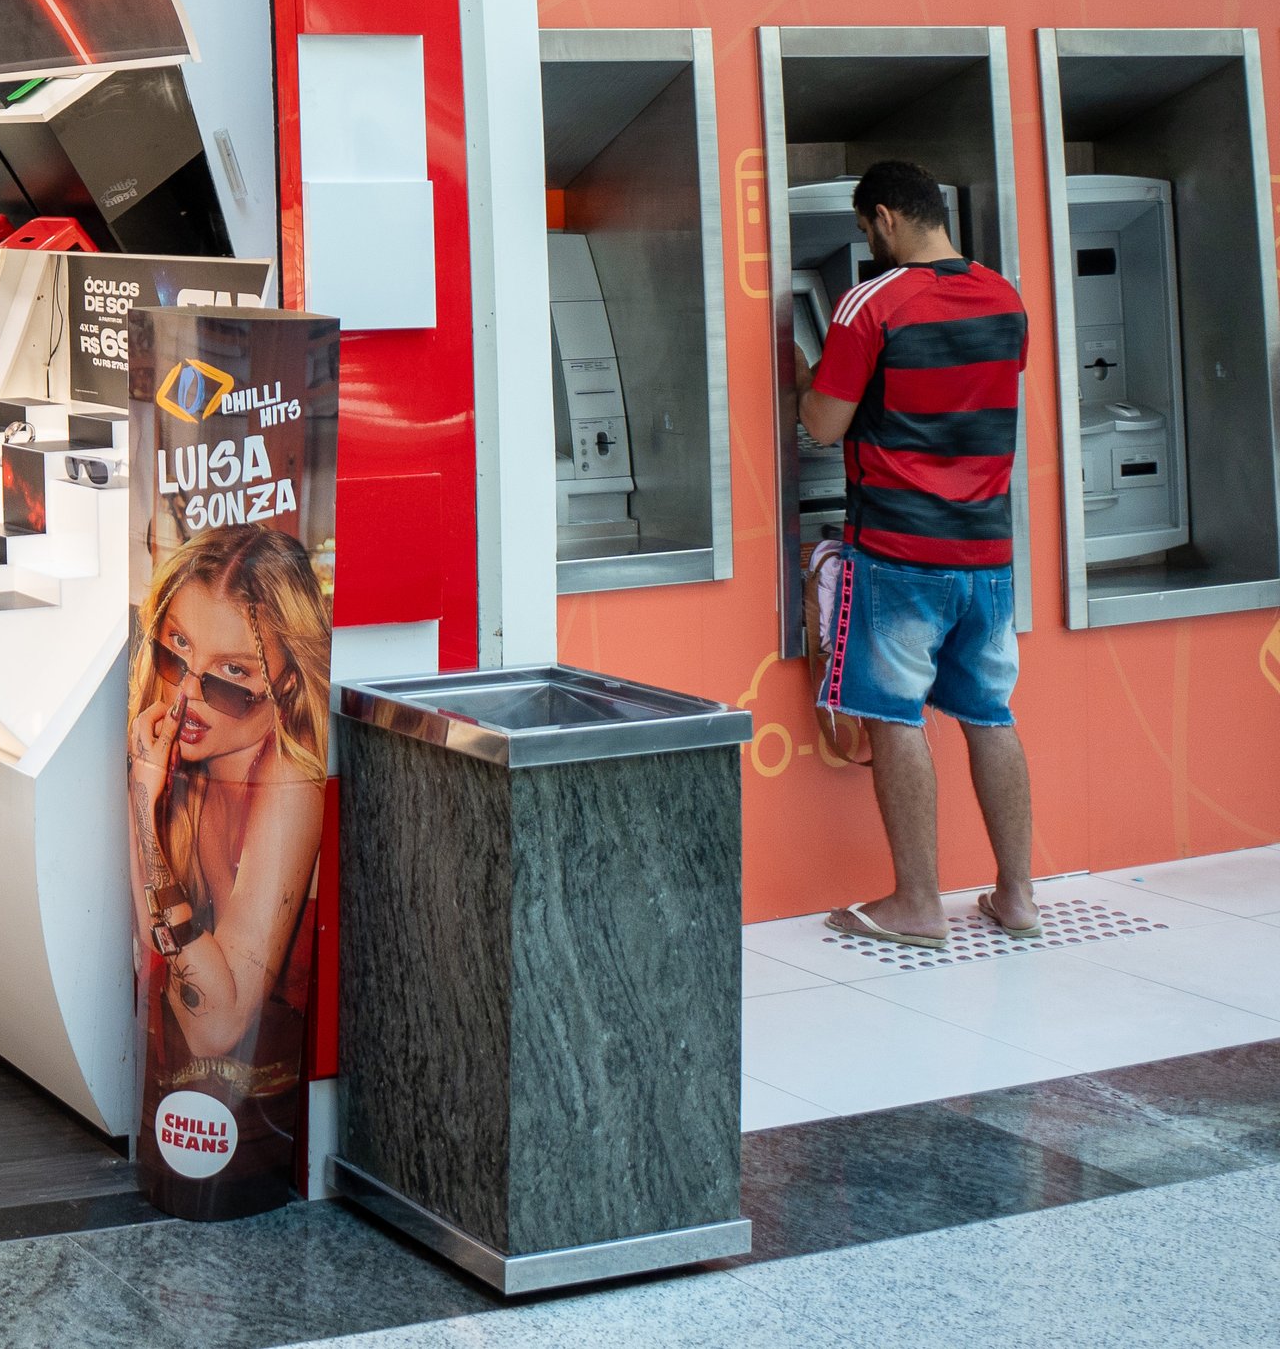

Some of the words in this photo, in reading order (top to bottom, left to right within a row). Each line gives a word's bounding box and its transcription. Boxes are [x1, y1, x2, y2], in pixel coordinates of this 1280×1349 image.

[84, 275, 140, 298] ÓCULOS
[84, 294, 105, 313] DE
[79, 323, 89, 332] 4X
[89, 324, 100, 334] DE
[80, 335, 101, 355] R$
[100, 328, 128, 360] 69
[92, 357, 102, 367] OU
[102, 358, 112, 369] R$
[221, 381, 283, 415] CHILLI
[259, 399, 302, 429] HITS
[157, 434, 273, 495] LUISA
[184, 478, 298, 531] SONZA
[164, 1112, 227, 1137] CHILLI
[161, 1127, 229, 1154] BEANS
